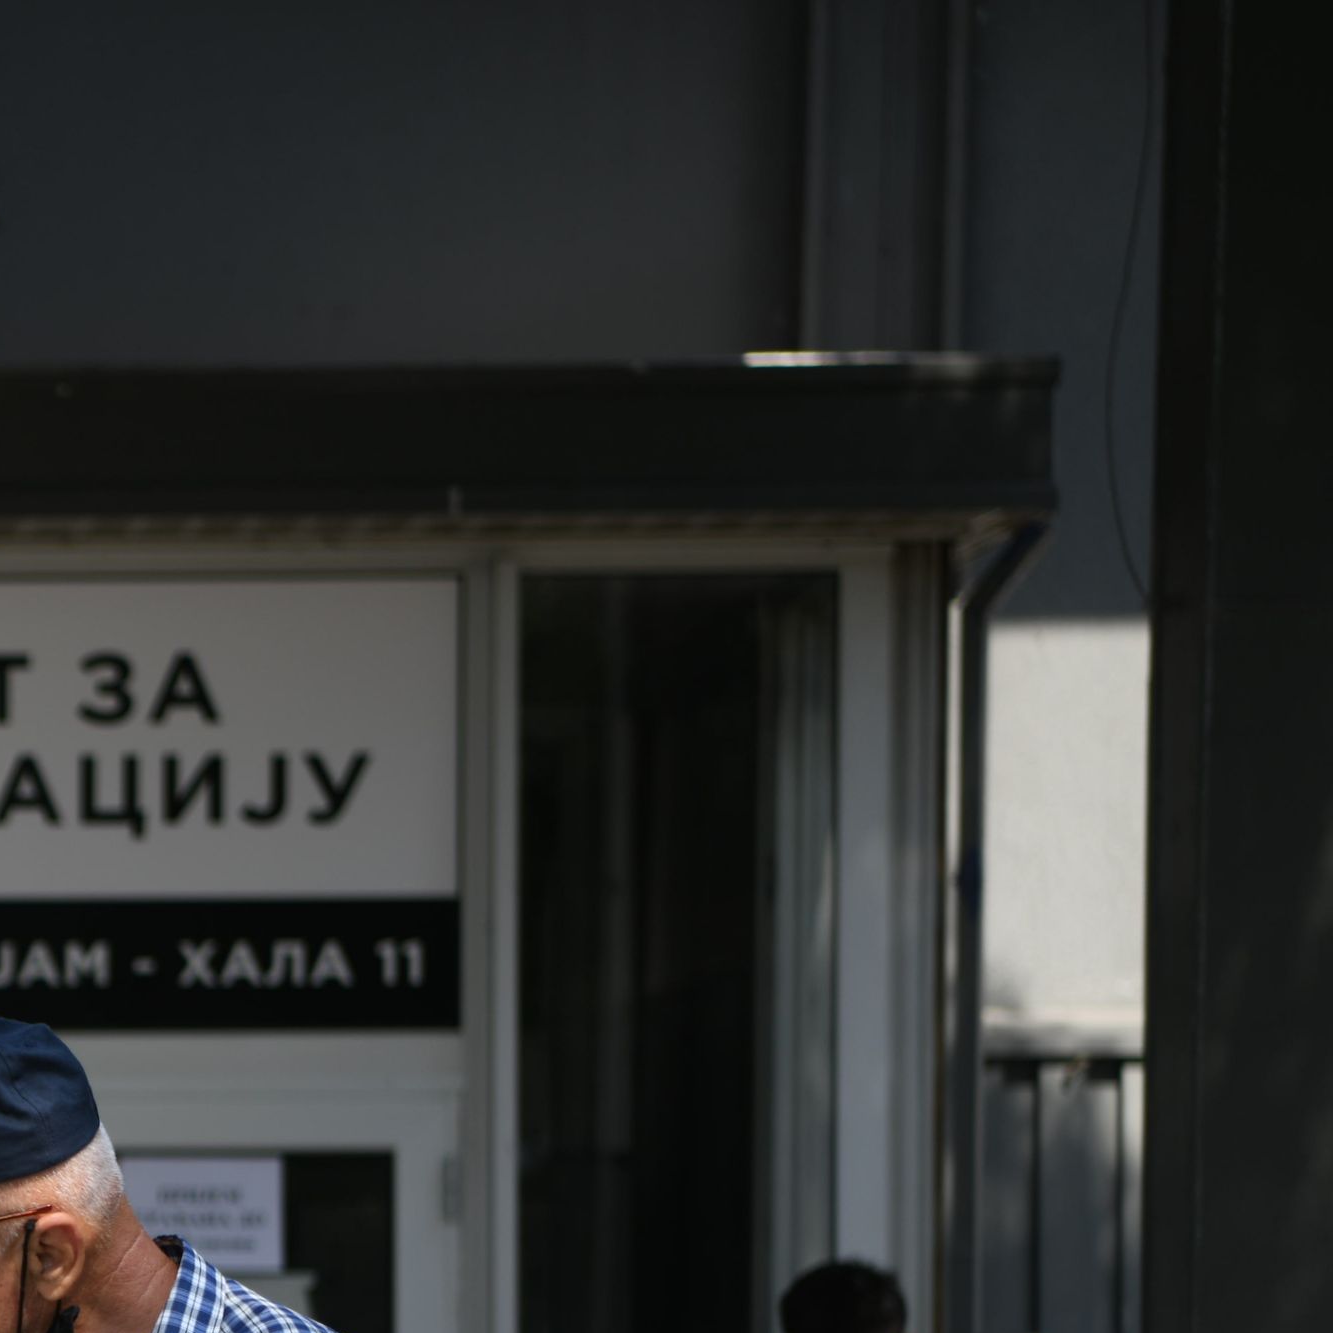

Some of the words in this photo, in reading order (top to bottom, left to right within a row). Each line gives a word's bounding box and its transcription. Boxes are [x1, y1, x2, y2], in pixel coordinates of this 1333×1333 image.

[78, 651, 220, 726] ЗА
[179, 940, 353, 987] ХАЛА
[375, 939, 425, 986] 11
